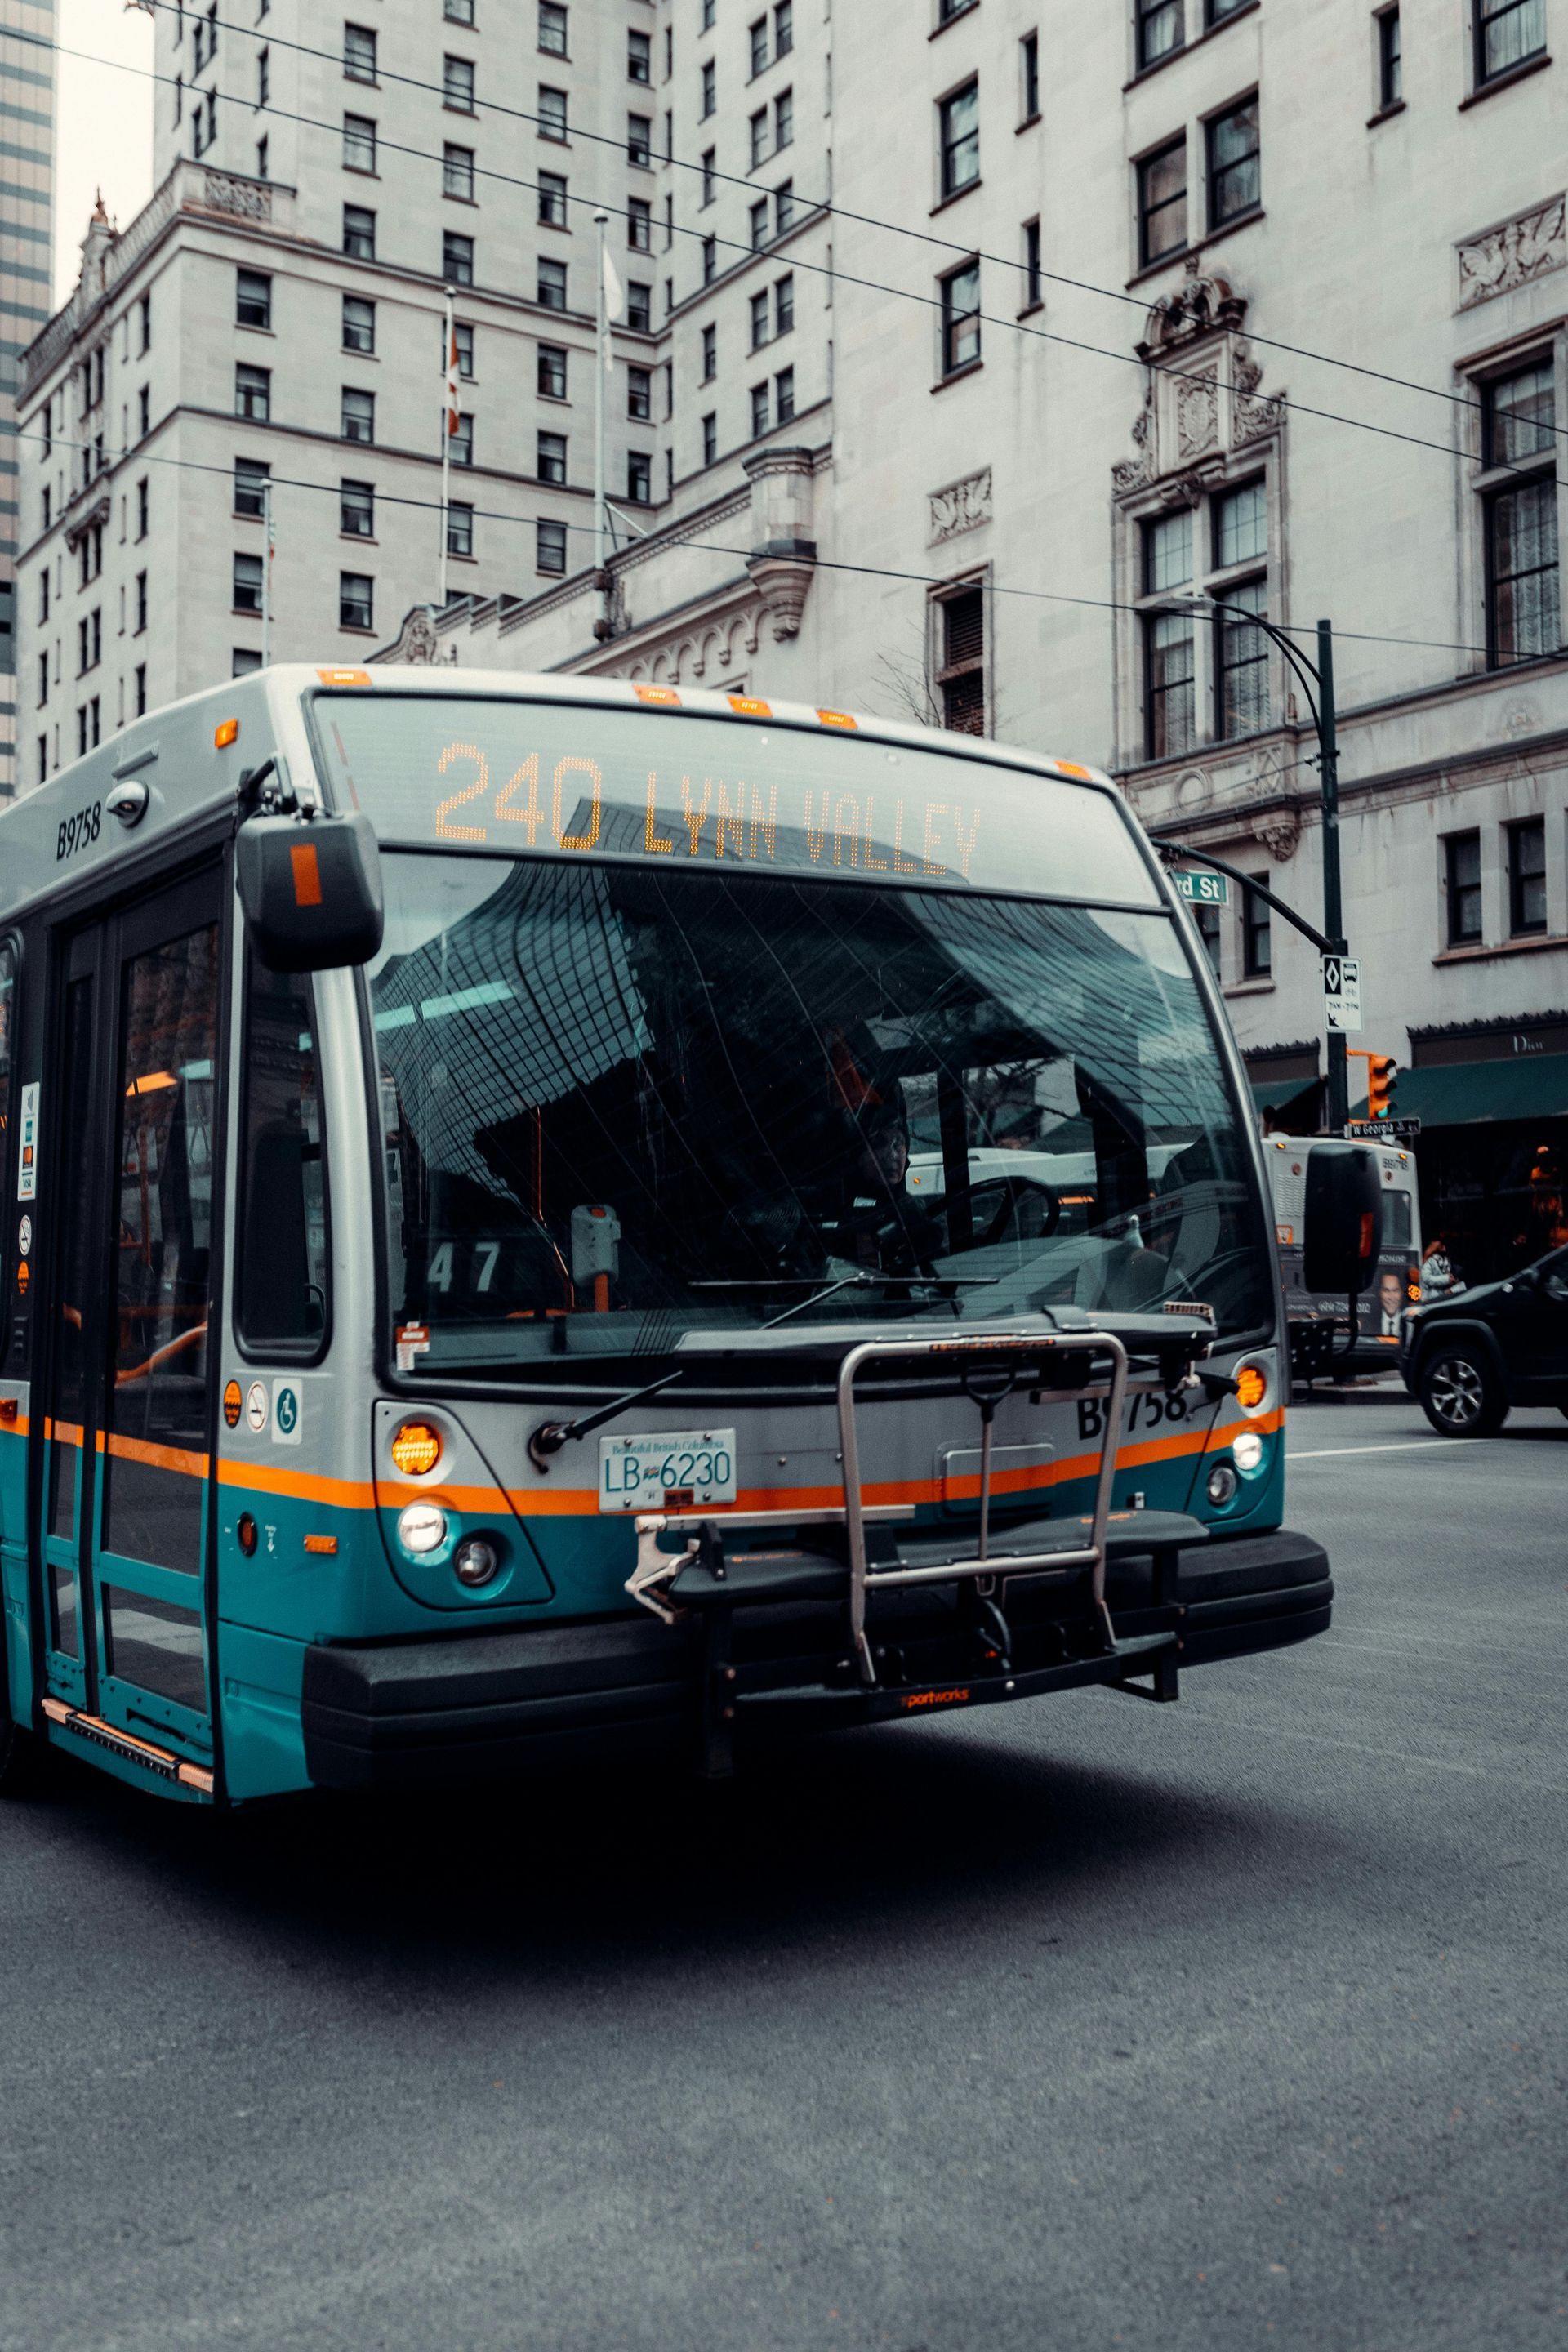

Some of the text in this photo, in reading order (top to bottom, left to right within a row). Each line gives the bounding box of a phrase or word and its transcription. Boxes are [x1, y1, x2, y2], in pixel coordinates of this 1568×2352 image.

[435, 743, 981, 877] 240 LYNN VALLEY
[56, 800, 101, 862] B9758
[1200, 876, 1219, 899] St
[1513, 1036, 1544, 1053] Dior
[1362, 1121, 1394, 1137] Georgia
[653, 1441, 680, 1453] British
[605, 1451, 731, 1493] LB 6230
